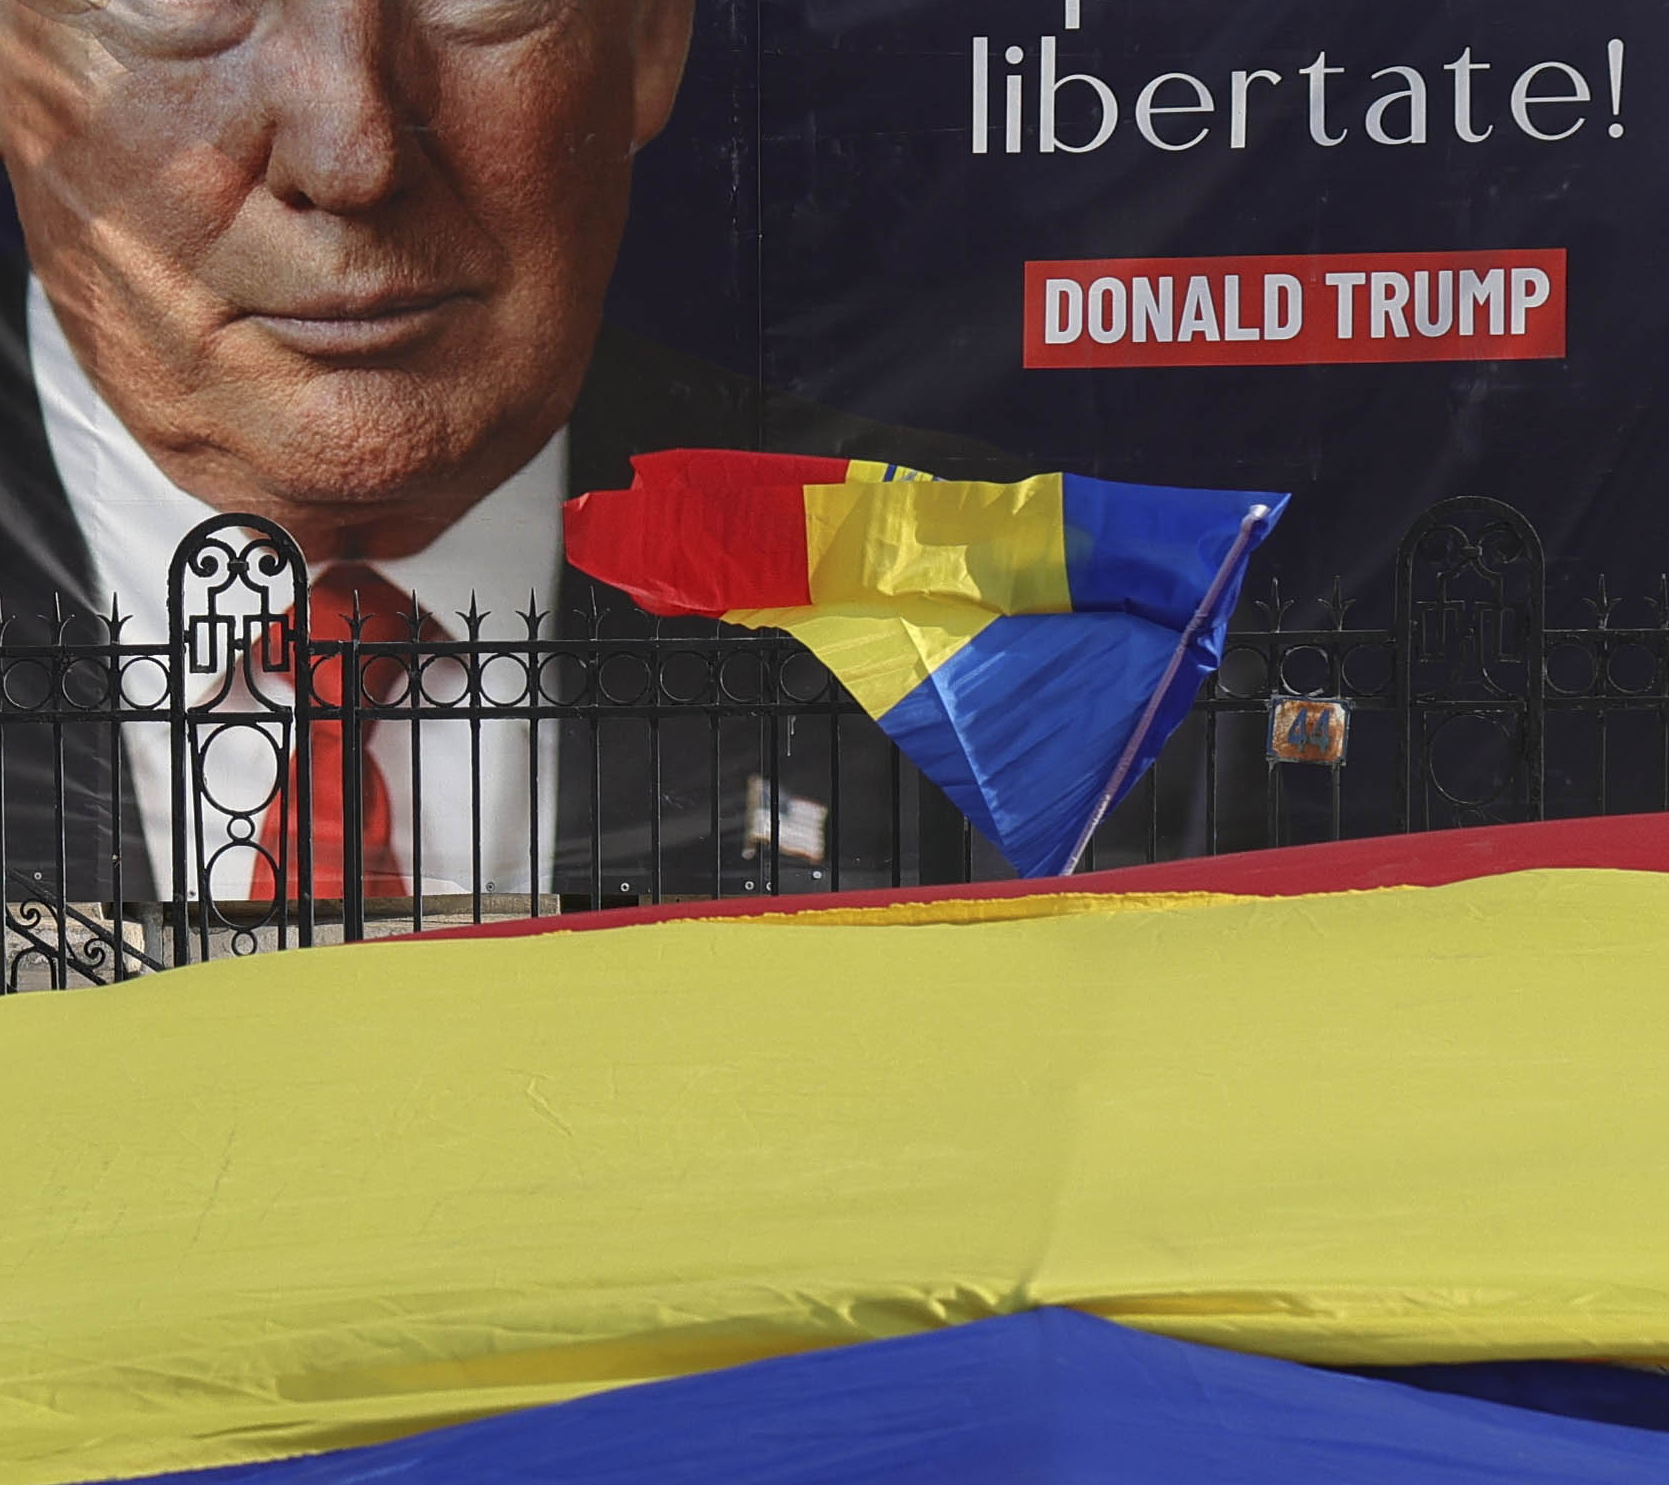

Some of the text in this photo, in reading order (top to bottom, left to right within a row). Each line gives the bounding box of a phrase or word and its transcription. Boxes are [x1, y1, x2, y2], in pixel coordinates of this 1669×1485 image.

[972, 36, 1625, 154] libertate!
[1044, 267, 1552, 345] DONALD TRUMP
[1288, 707, 1330, 754] 44
